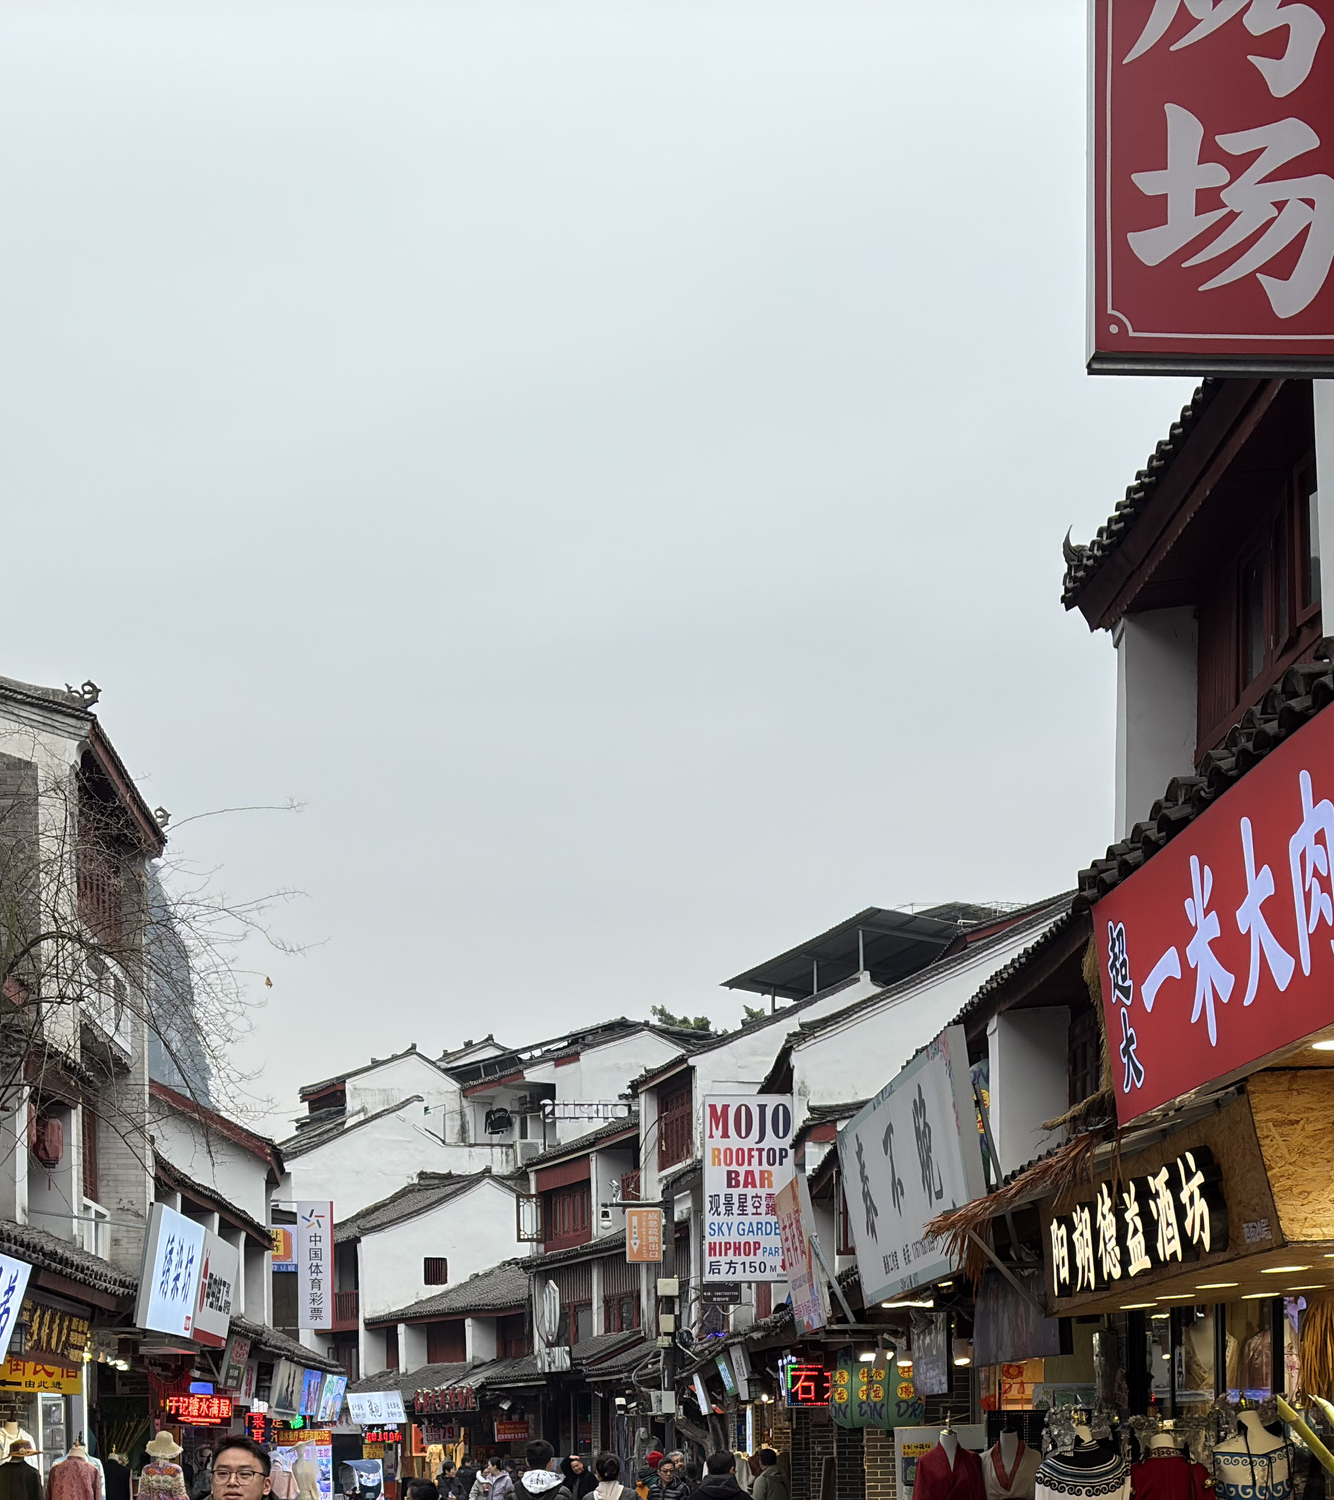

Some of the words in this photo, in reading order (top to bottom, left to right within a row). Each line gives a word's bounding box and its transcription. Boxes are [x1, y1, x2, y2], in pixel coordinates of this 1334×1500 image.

[1106, 920, 1145, 1094] 超大
[707, 1102, 791, 1145] MOJO
[711, 1147, 788, 1167] ROOFTOP
[725, 1170, 774, 1189] BAR
[708, 1222, 734, 1237] SKY
[1049, 1150, 1213, 1299] 阳朔德益酒坊
[708, 1241, 761, 1257] HIPHOP
[307, 1233, 324, 1321] 中国体育彩票
[708, 1260, 767, 1275] 后方150
